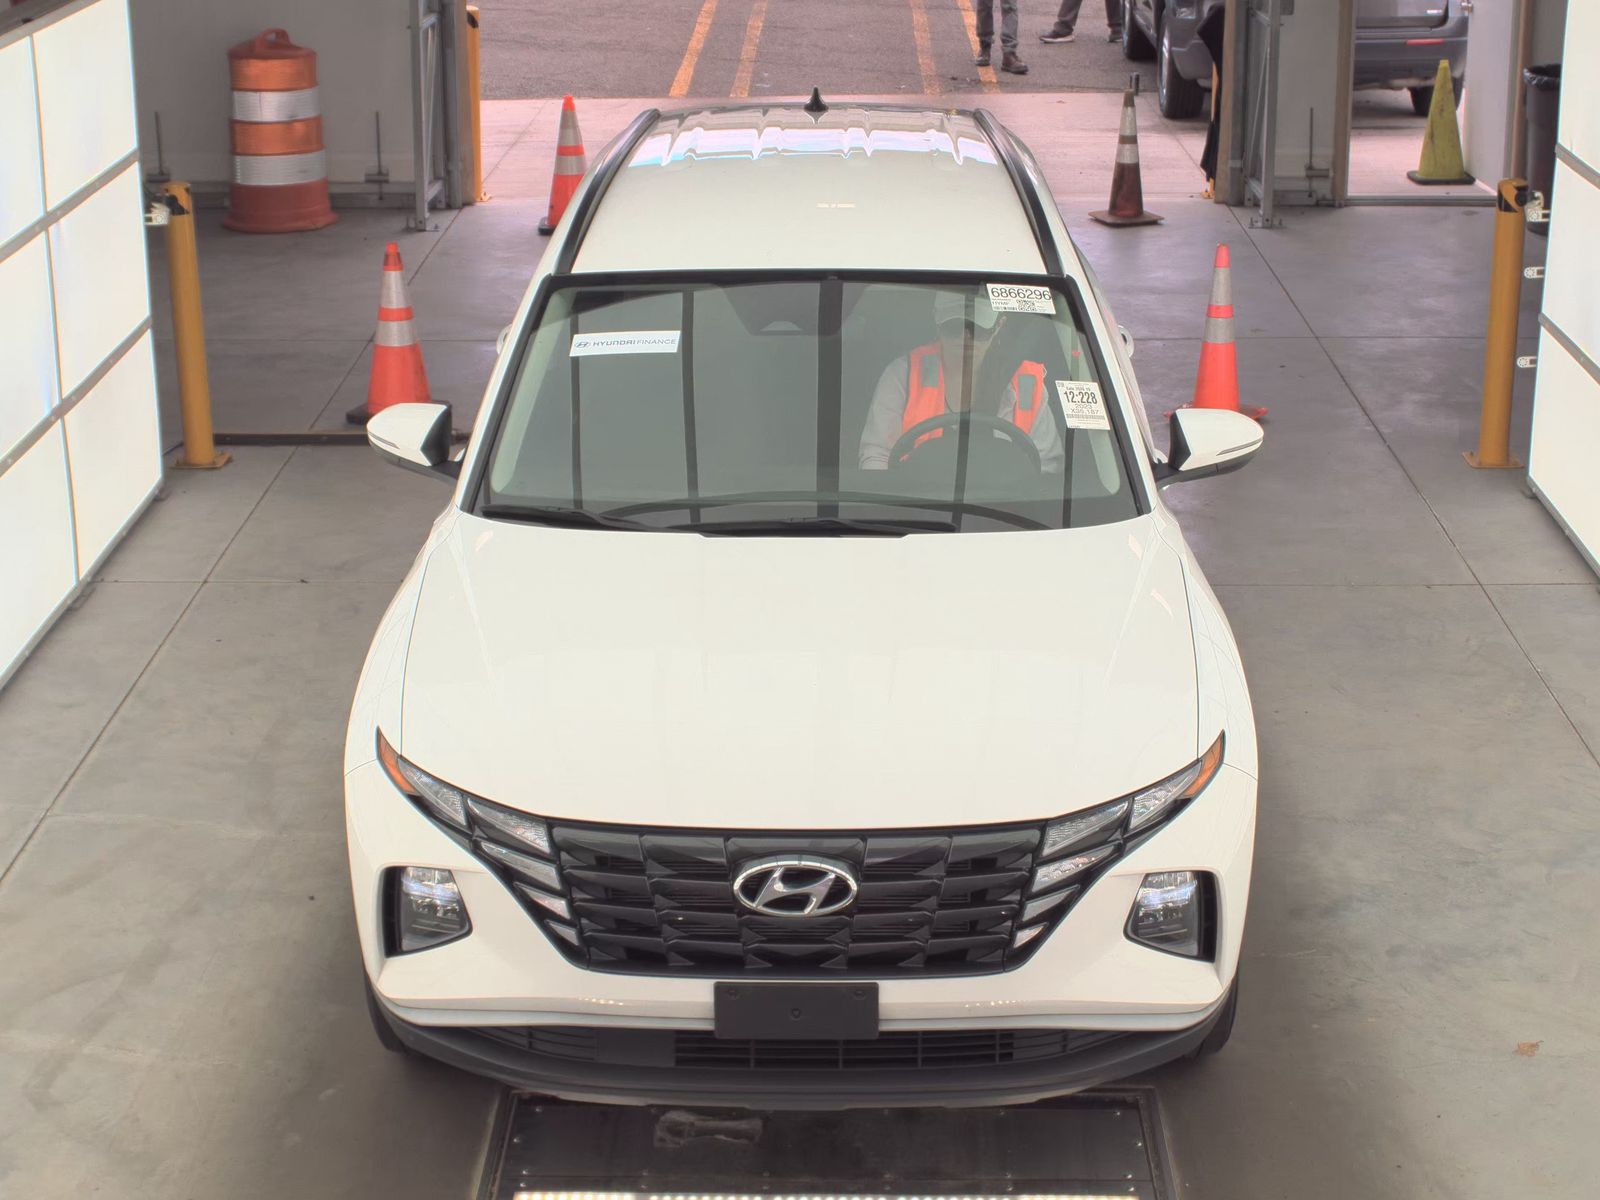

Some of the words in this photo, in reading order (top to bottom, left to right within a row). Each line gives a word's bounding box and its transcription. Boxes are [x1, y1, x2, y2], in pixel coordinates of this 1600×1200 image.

[991, 287, 1052, 301] 6866296
[592, 339, 636, 347] HYUNDAI
[1063, 390, 1098, 405] 12:228
